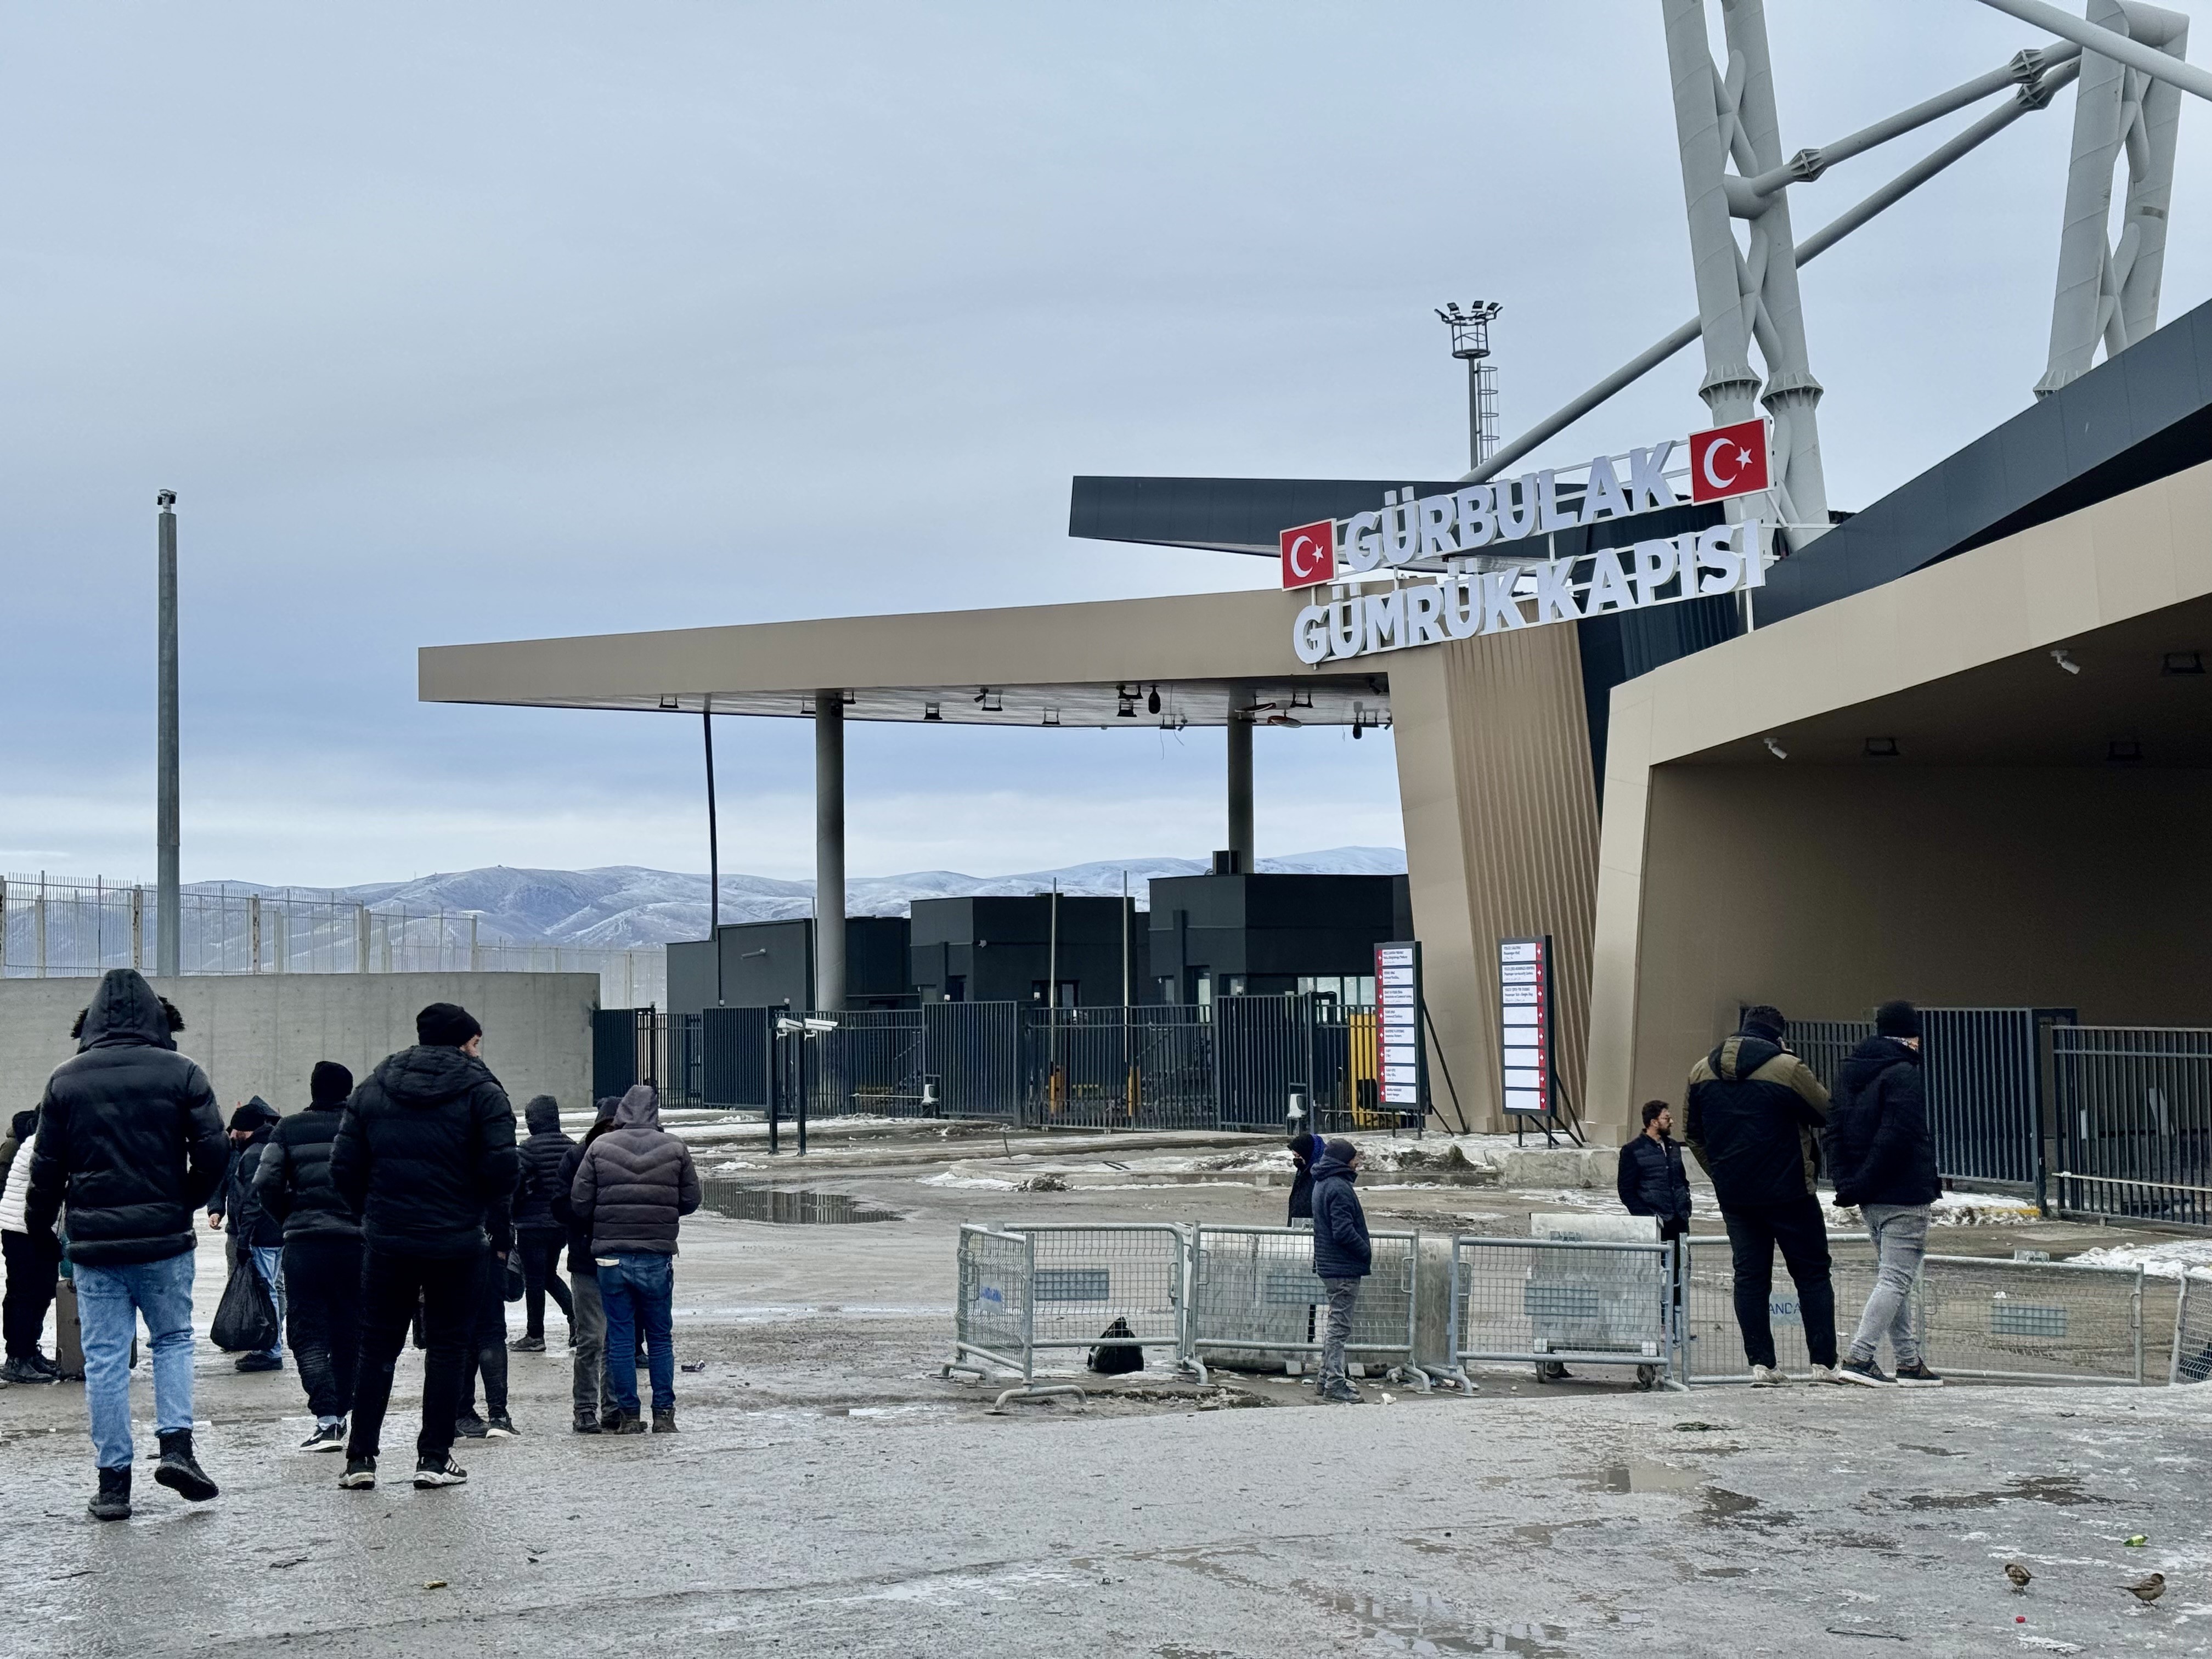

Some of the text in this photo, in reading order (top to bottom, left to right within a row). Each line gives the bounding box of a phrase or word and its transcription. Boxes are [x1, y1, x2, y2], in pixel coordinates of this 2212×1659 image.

[1346, 441, 1679, 572] GÜRBULAK
[1294, 519, 1766, 664] GÜMRÜK KAPISI
